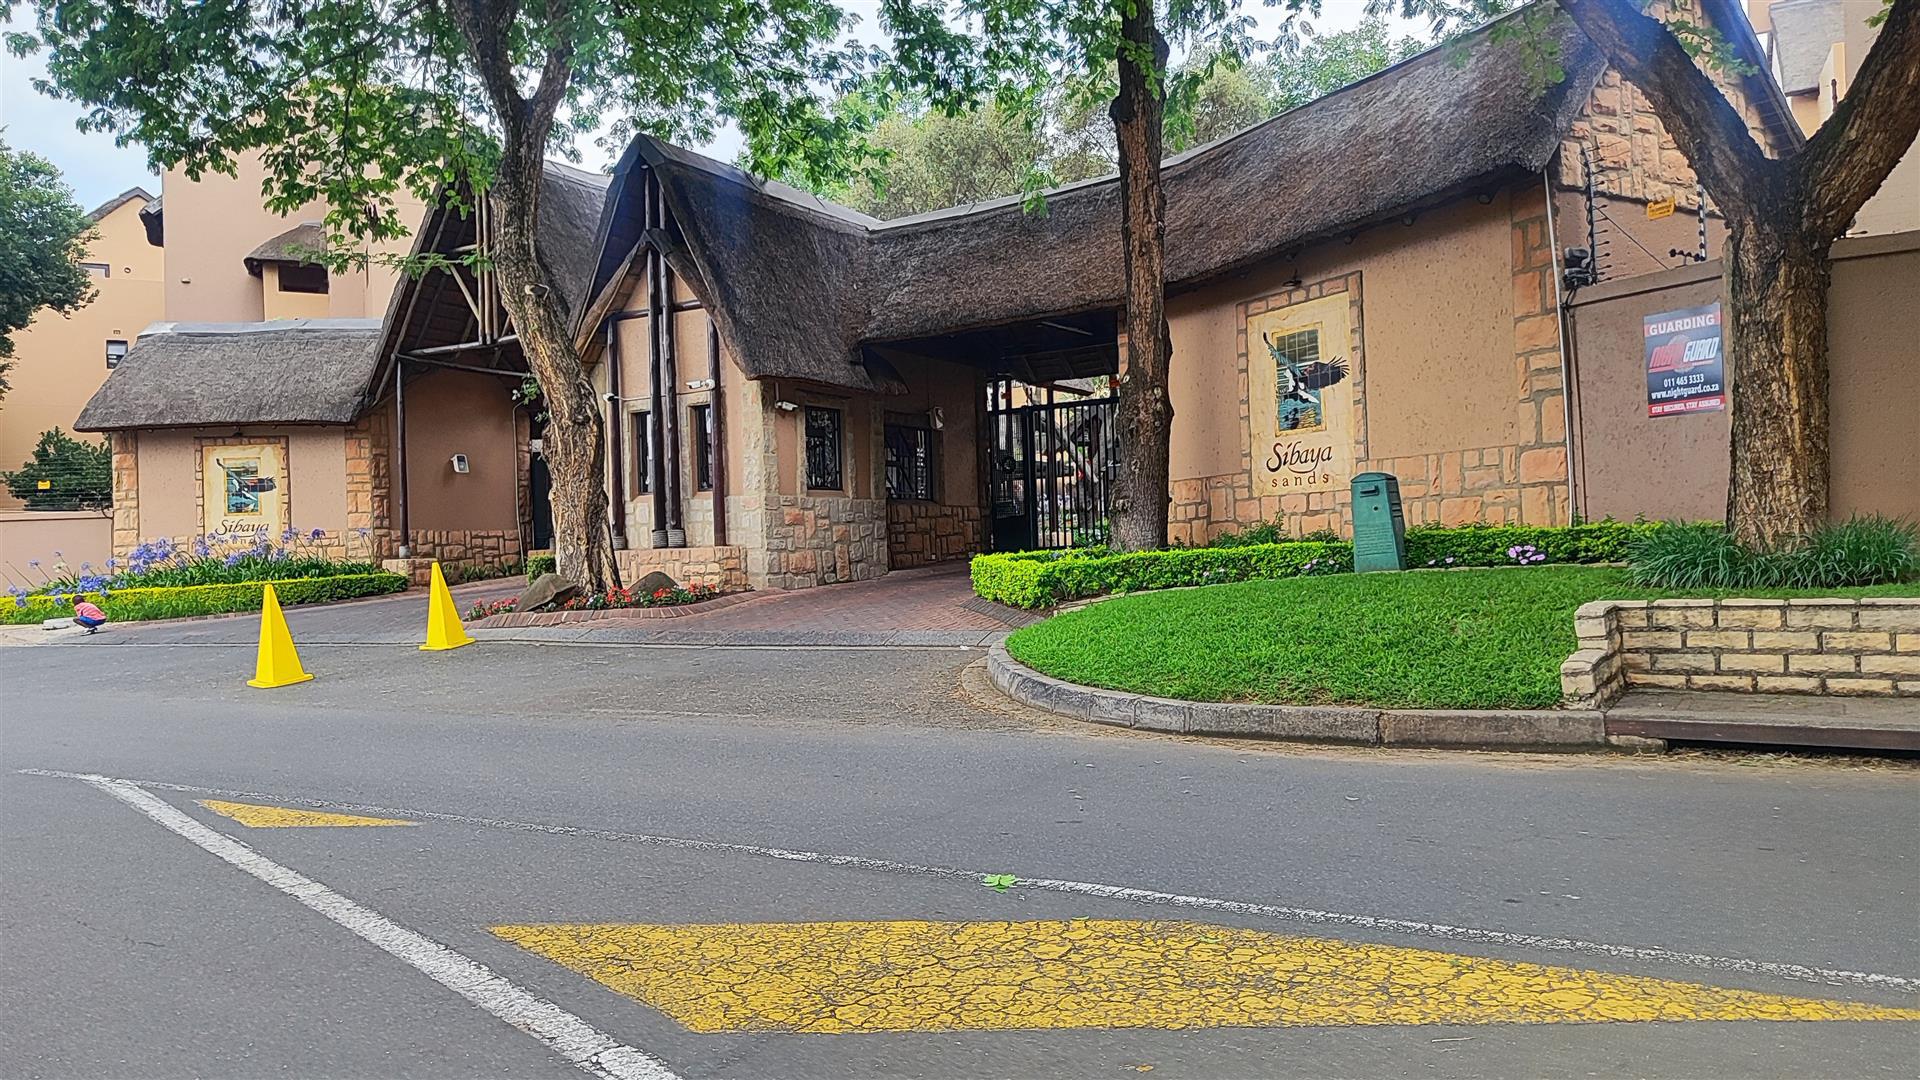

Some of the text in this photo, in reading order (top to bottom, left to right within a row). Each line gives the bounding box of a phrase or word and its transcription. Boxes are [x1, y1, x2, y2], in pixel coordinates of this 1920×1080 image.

[1650, 315, 1714, 335] GUARDING
[1663, 373, 1704, 388] 011 465 3333
[1651, 383, 1719, 399] www.nightguard.co.za
[1266, 440, 1333, 474] Sibaya
[1271, 471, 1329, 487] sands
[215, 518, 270, 537] Sibaya
